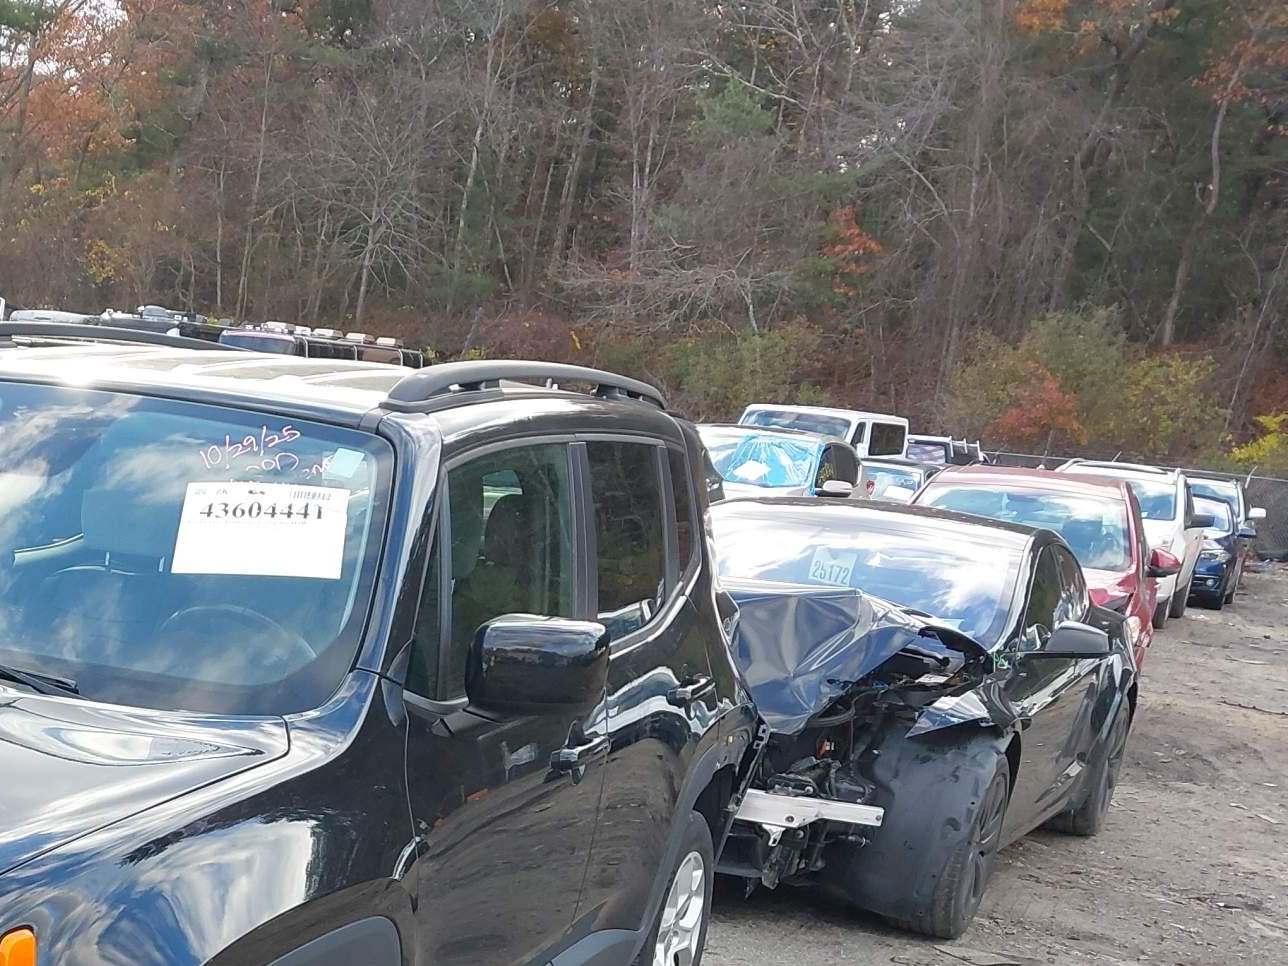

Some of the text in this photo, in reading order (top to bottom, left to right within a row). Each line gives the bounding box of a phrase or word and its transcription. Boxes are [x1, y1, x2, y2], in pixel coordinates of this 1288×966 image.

[199, 425, 301, 469] 10/29/25
[199, 501, 323, 519] 43604441
[812, 560, 850, 585] 25172
